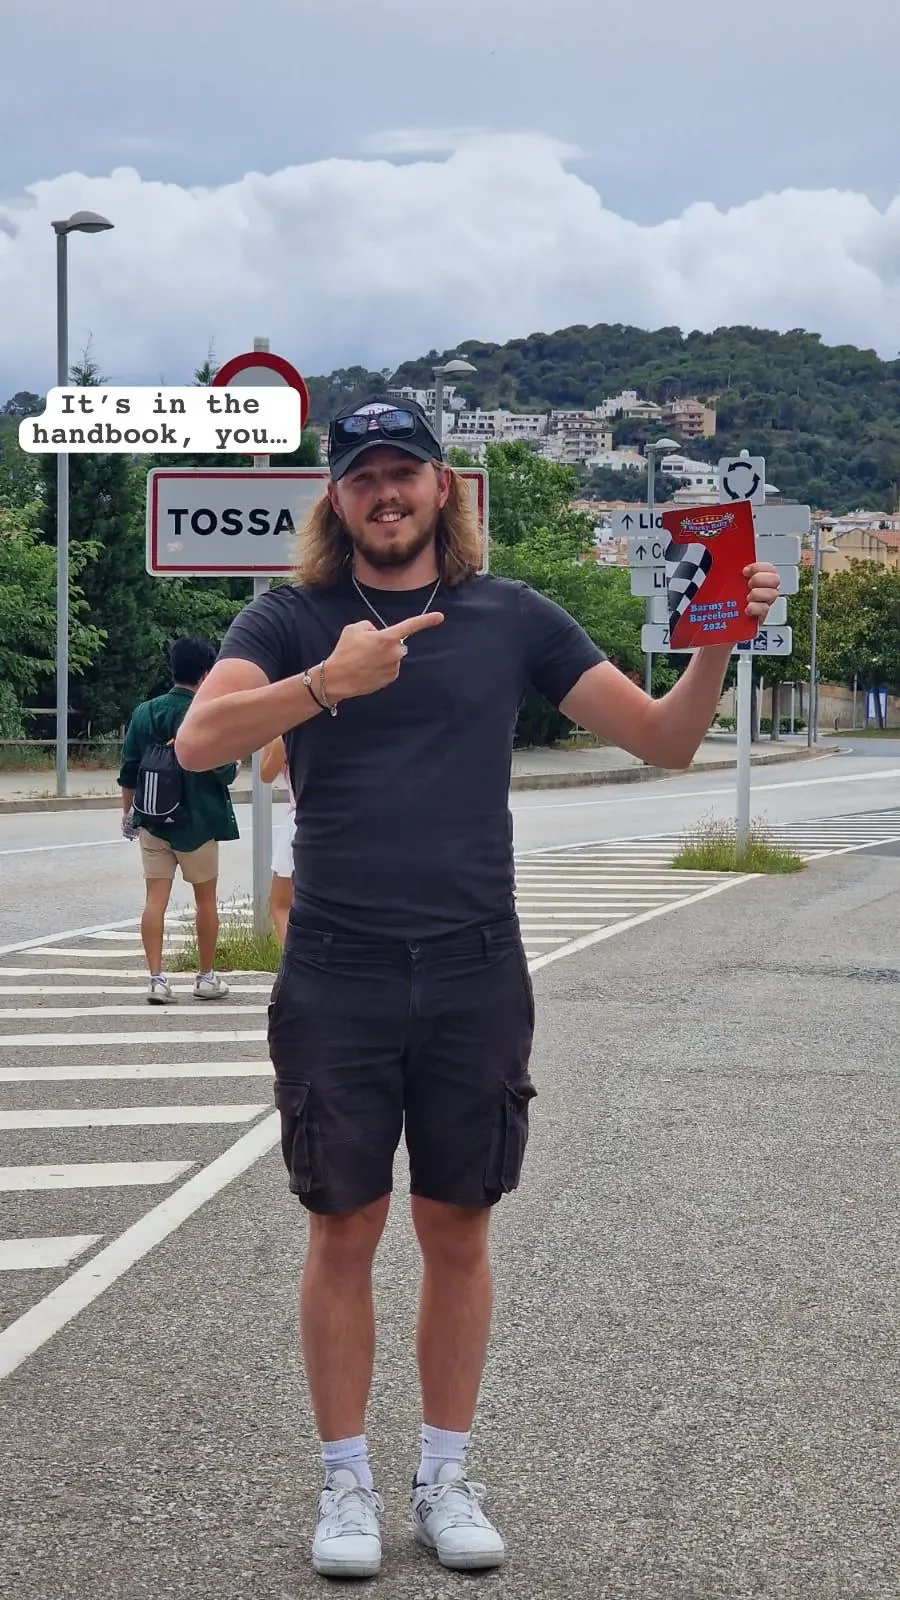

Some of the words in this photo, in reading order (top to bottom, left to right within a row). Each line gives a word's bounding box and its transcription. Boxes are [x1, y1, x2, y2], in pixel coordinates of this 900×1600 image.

[168, 508, 296, 536] TOSSA
[688, 522, 710, 532] Wacky
[711, 520, 728, 530] Rally
[691, 602, 724, 613] Barmy
[726, 600, 737, 608] to
[689, 610, 739, 623] Barcelona
[703, 622, 727, 631] 2024
